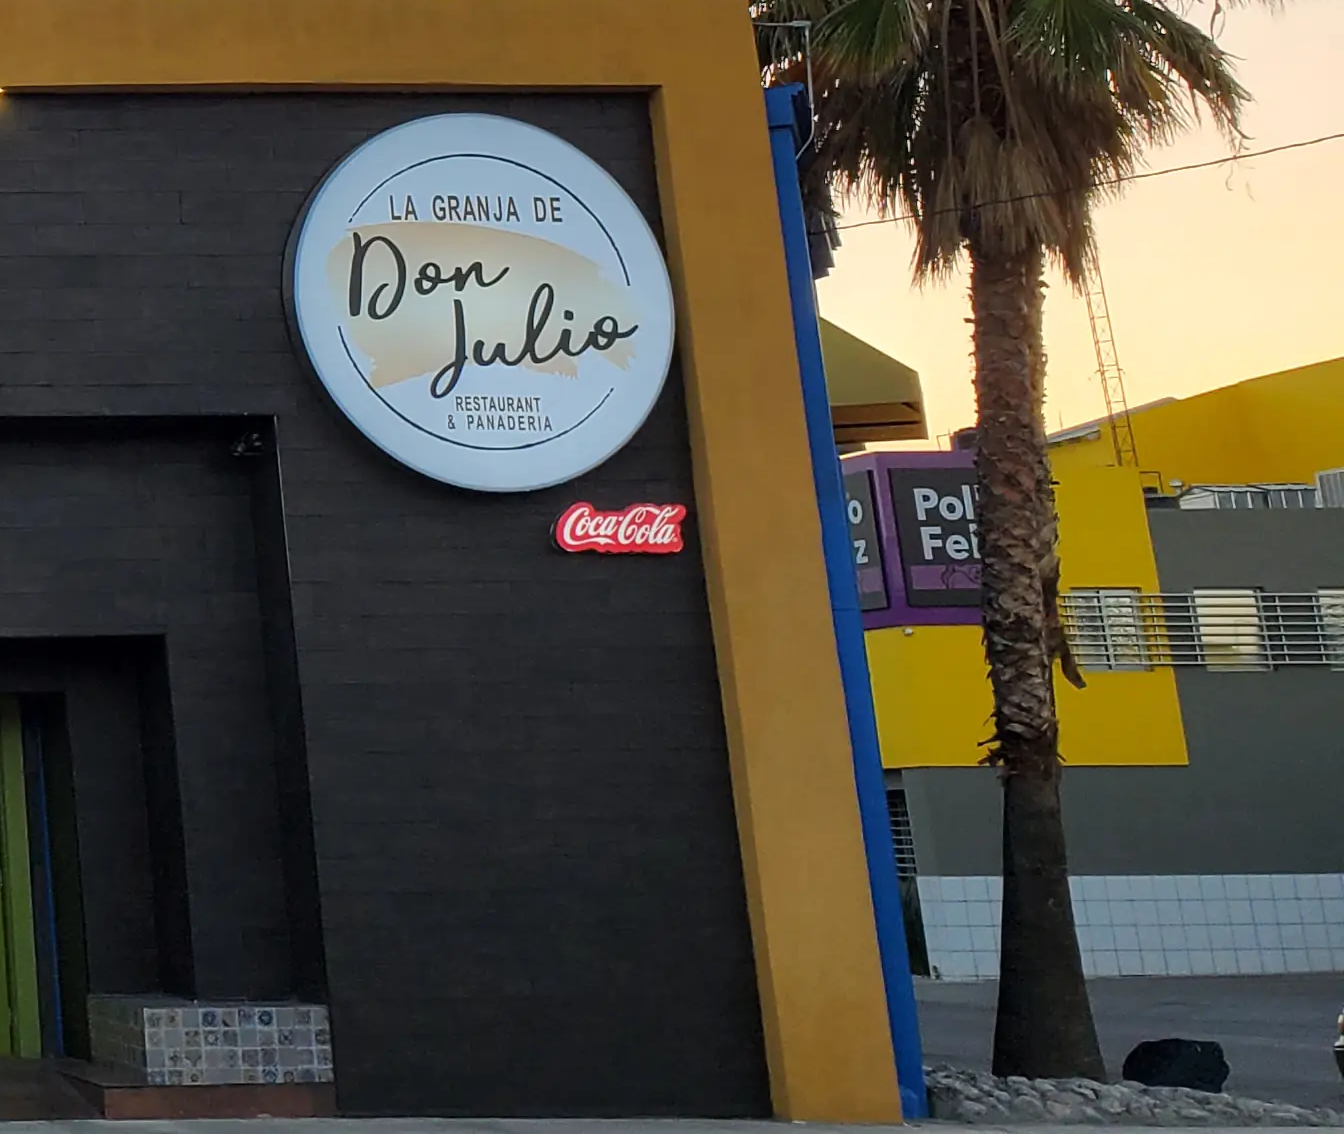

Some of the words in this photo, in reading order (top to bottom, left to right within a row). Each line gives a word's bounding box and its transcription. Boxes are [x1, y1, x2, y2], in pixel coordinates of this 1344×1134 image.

[389, 194, 419, 222] LA
[432, 194, 521, 223] GRANJA
[533, 196, 564, 223] DE
[348, 231, 511, 321] Don
[430, 282, 639, 400] Julio
[454, 395, 541, 413] RESTAURANT
[447, 414, 456, 430] &
[466, 414, 553, 432] PANADERIA
[912, 484, 980, 521] Pol
[562, 506, 679, 546] Coca-Cola
